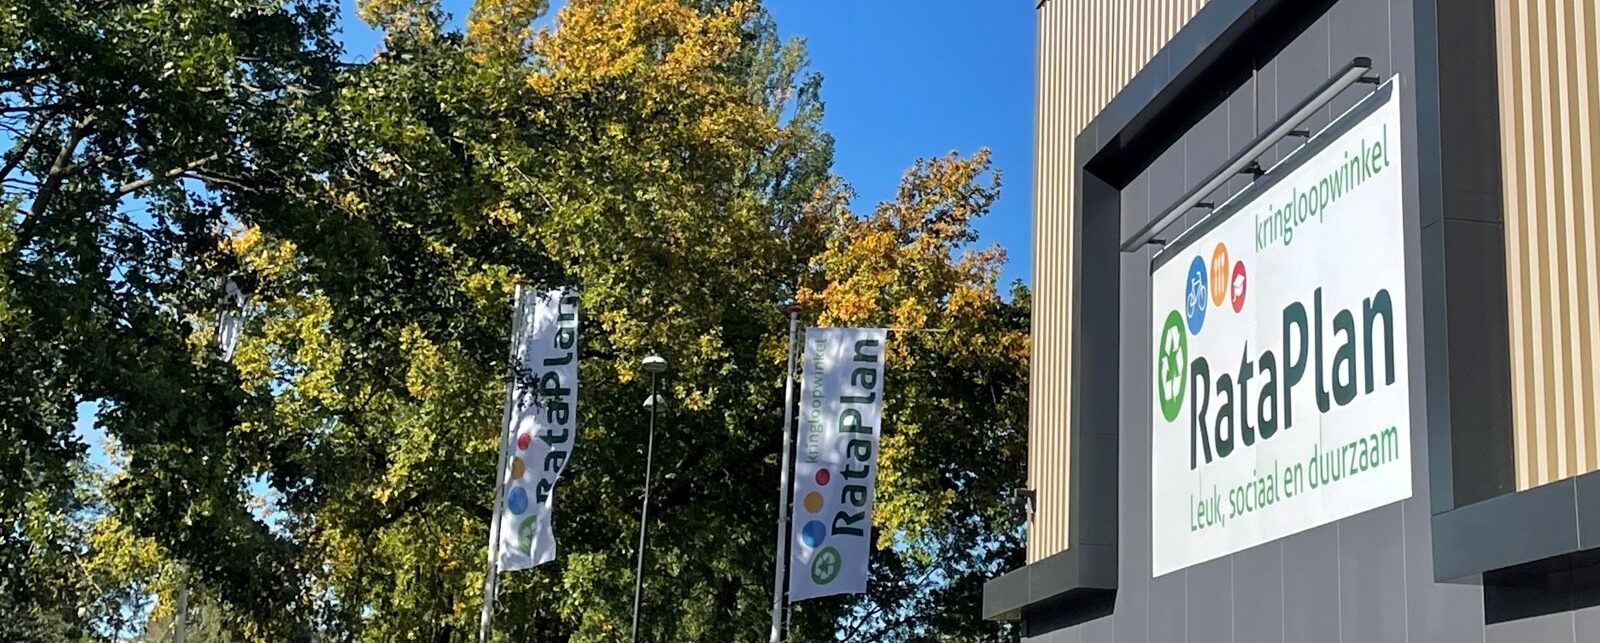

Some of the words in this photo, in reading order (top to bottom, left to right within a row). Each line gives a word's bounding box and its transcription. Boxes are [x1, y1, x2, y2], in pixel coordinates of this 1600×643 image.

[1255, 123, 1390, 252] kringloopwinkel
[805, 338, 829, 463] kringloopwinkel
[831, 339, 879, 537] RataPlan
[1190, 286, 1395, 470] RataPlan
[1190, 484, 1226, 532] Leuk,
[1229, 469, 1280, 519] sociaal
[1284, 461, 1304, 498] en
[1308, 425, 1399, 490] duurzaam
